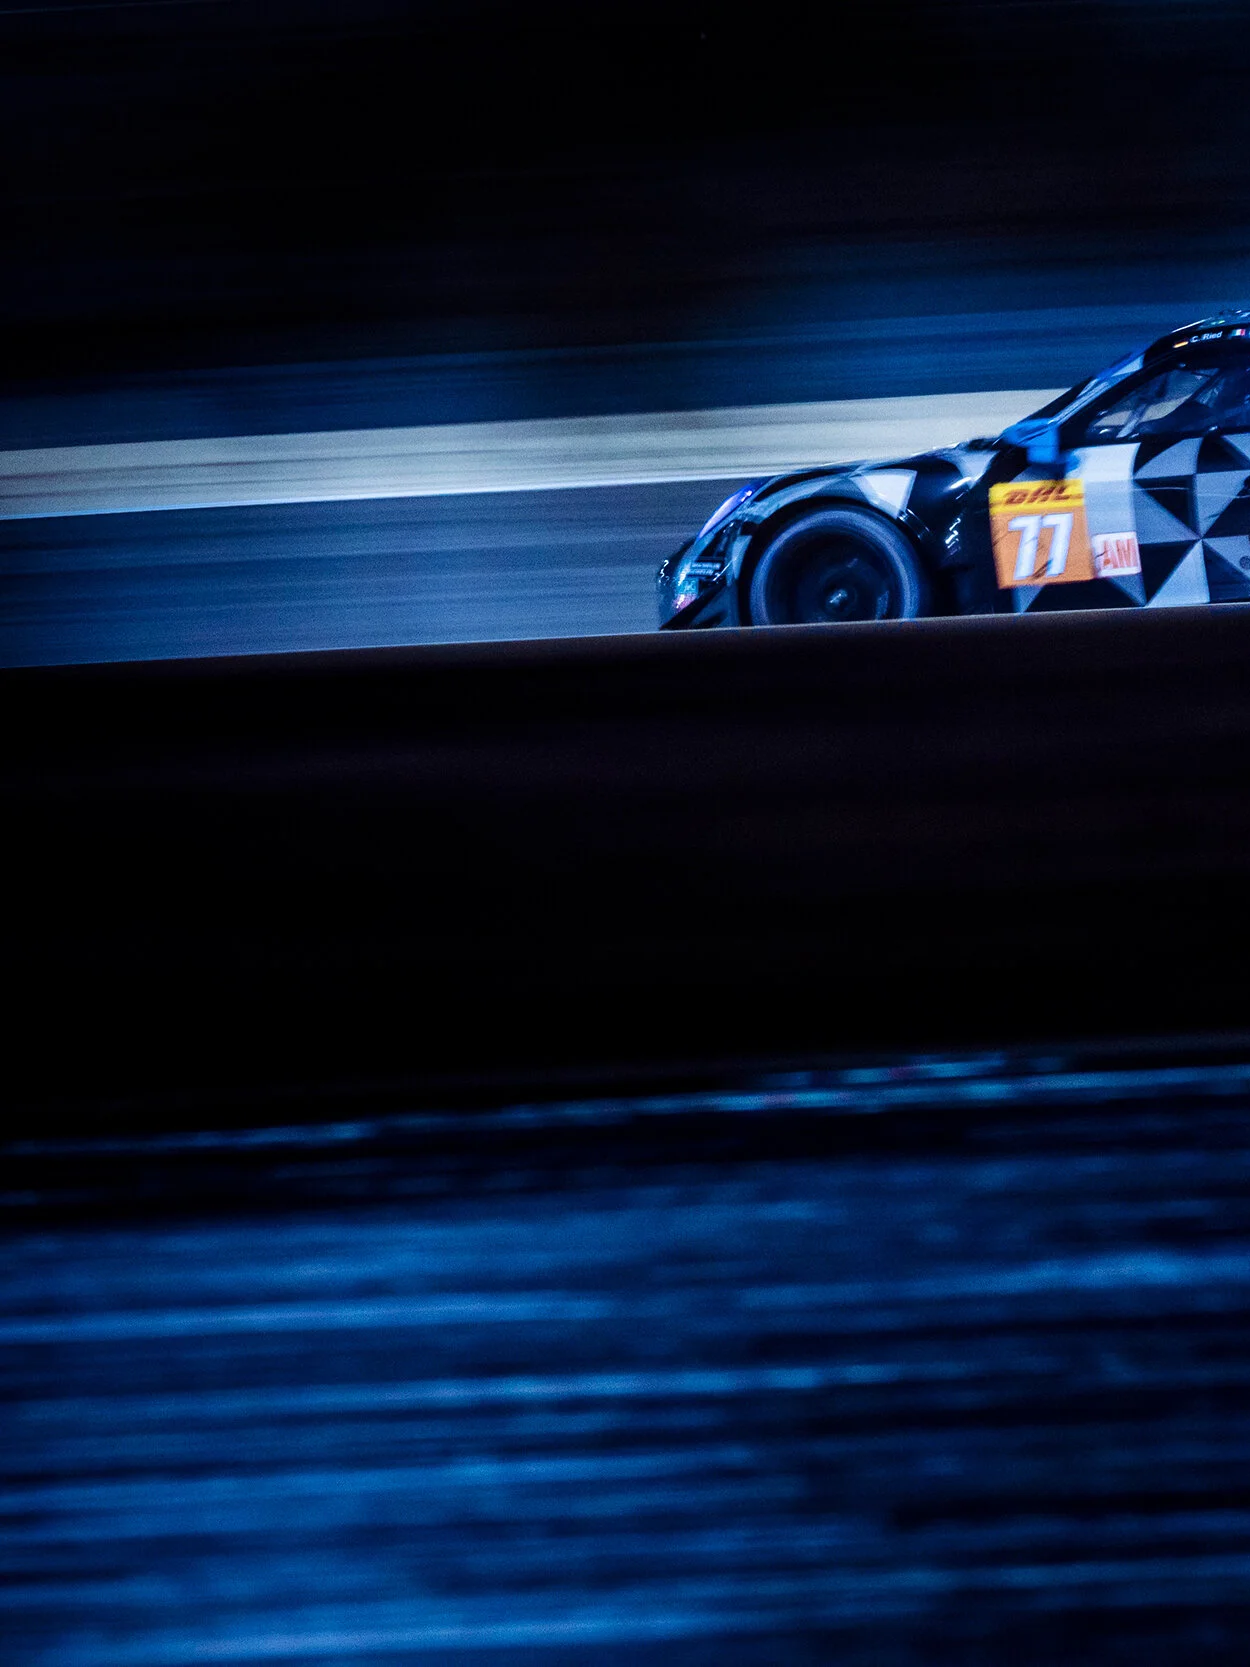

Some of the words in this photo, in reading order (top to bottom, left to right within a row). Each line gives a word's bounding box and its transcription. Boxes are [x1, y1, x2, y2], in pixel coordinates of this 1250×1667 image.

[1004, 486, 1070, 504] DHL
[1007, 512, 1074, 581] 77
[1100, 537, 1139, 569] AM
